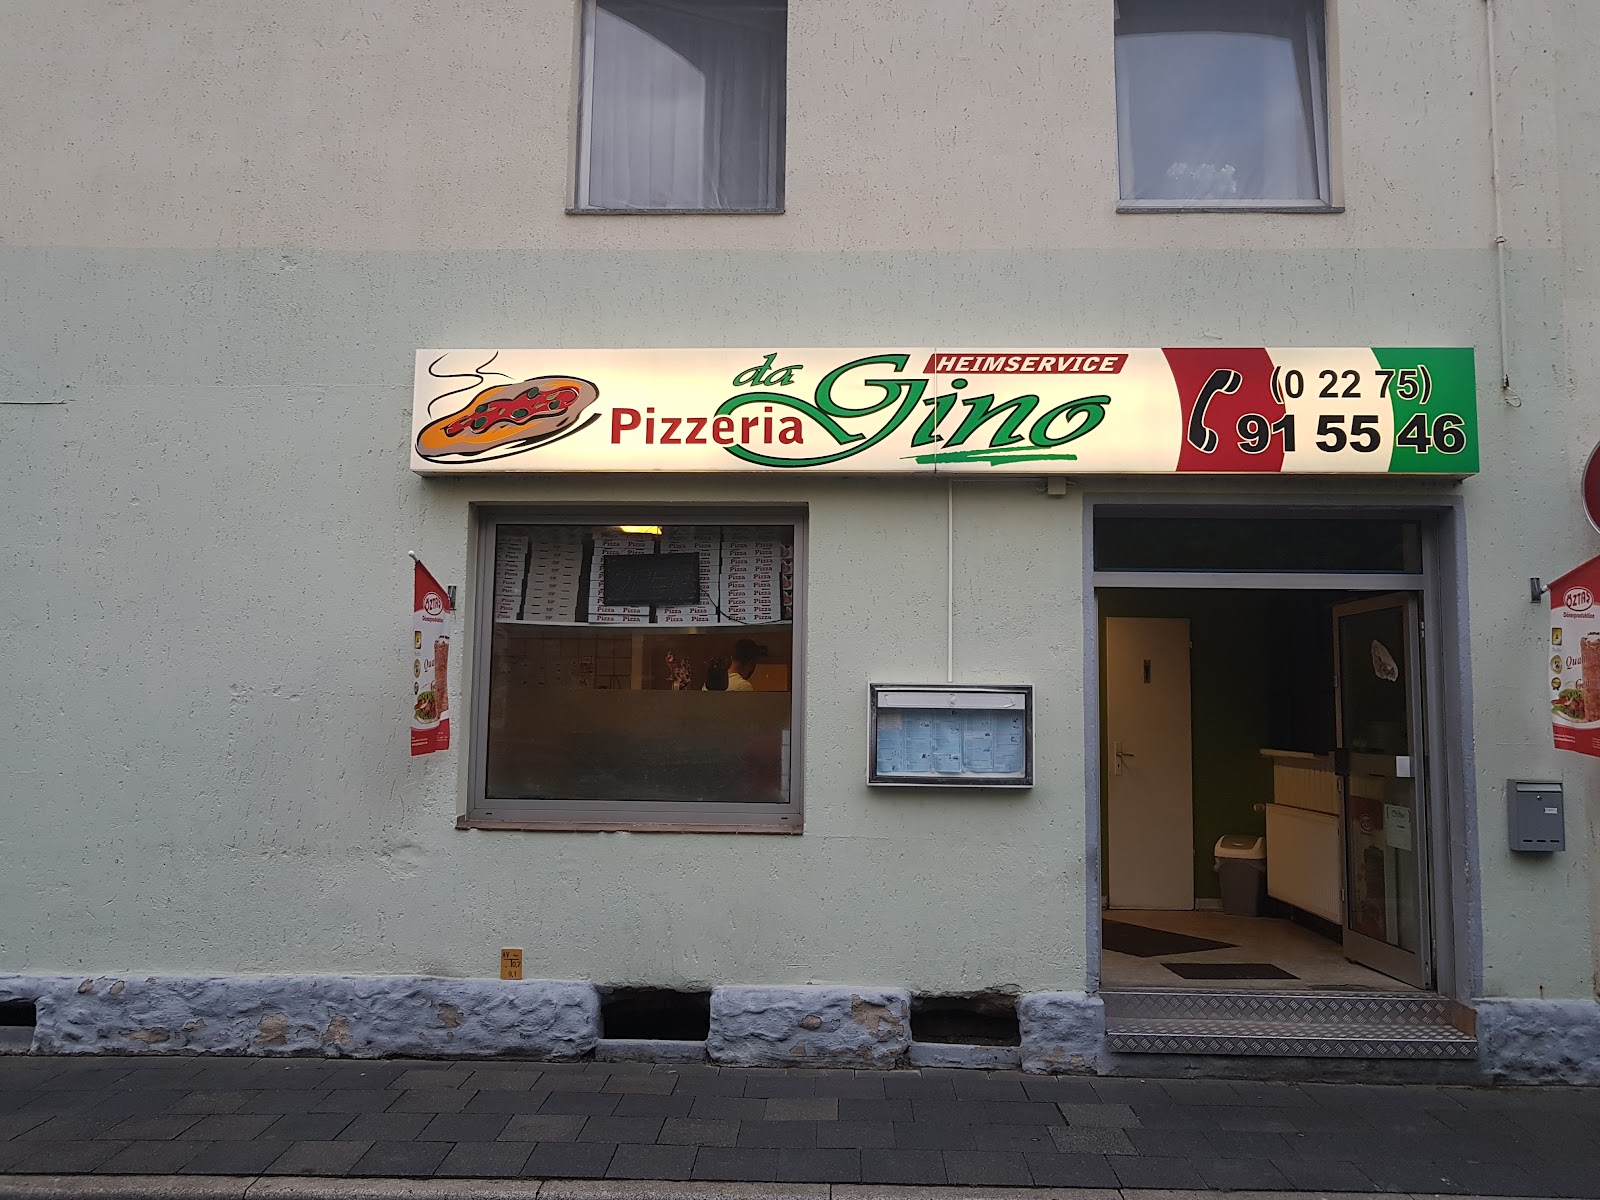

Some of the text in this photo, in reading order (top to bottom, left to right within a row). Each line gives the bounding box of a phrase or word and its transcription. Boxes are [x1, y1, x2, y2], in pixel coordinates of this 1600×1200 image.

[733, 352, 803, 388] da
[936, 355, 1122, 373] HEIMSERVICE
[1269, 364, 1433, 405] (0 22 75)
[610, 407, 804, 445] Pizzeria
[713, 353, 1112, 467] Gino
[1236, 413, 1467, 454] 91 55 46
